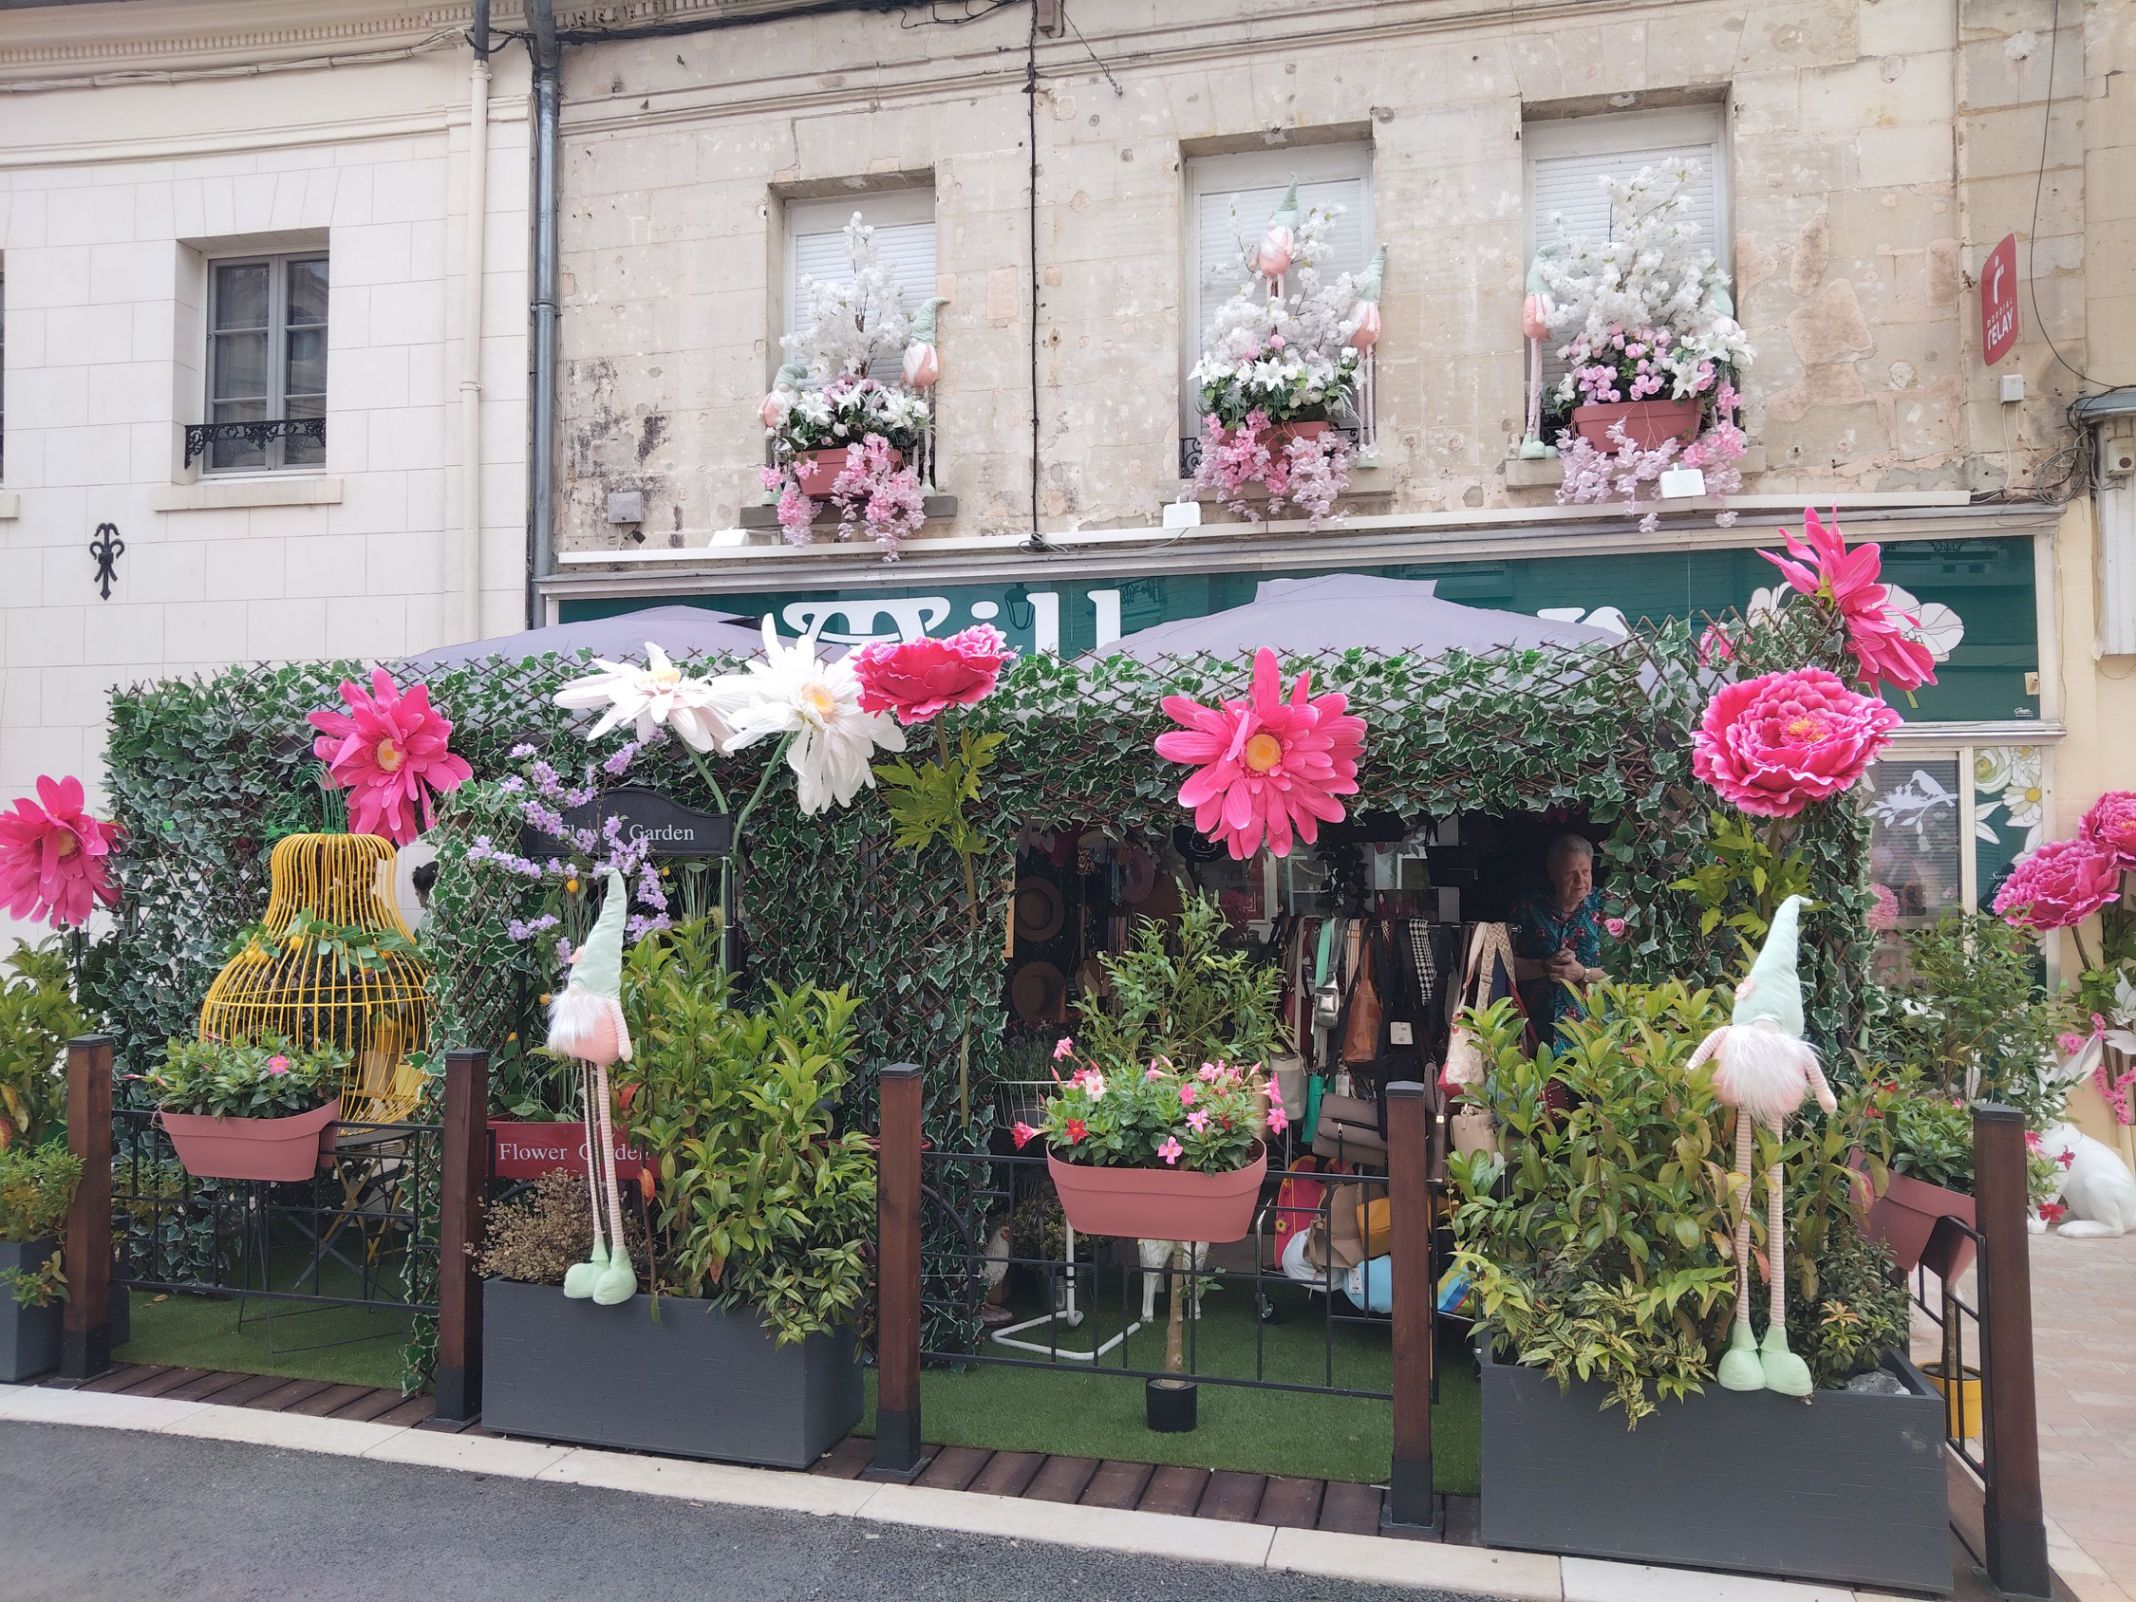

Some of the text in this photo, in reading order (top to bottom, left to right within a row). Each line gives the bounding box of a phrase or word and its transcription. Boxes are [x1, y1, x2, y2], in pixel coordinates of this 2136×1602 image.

[629, 824, 695, 841] Garden
[499, 1143, 650, 1160] Flower Gden
